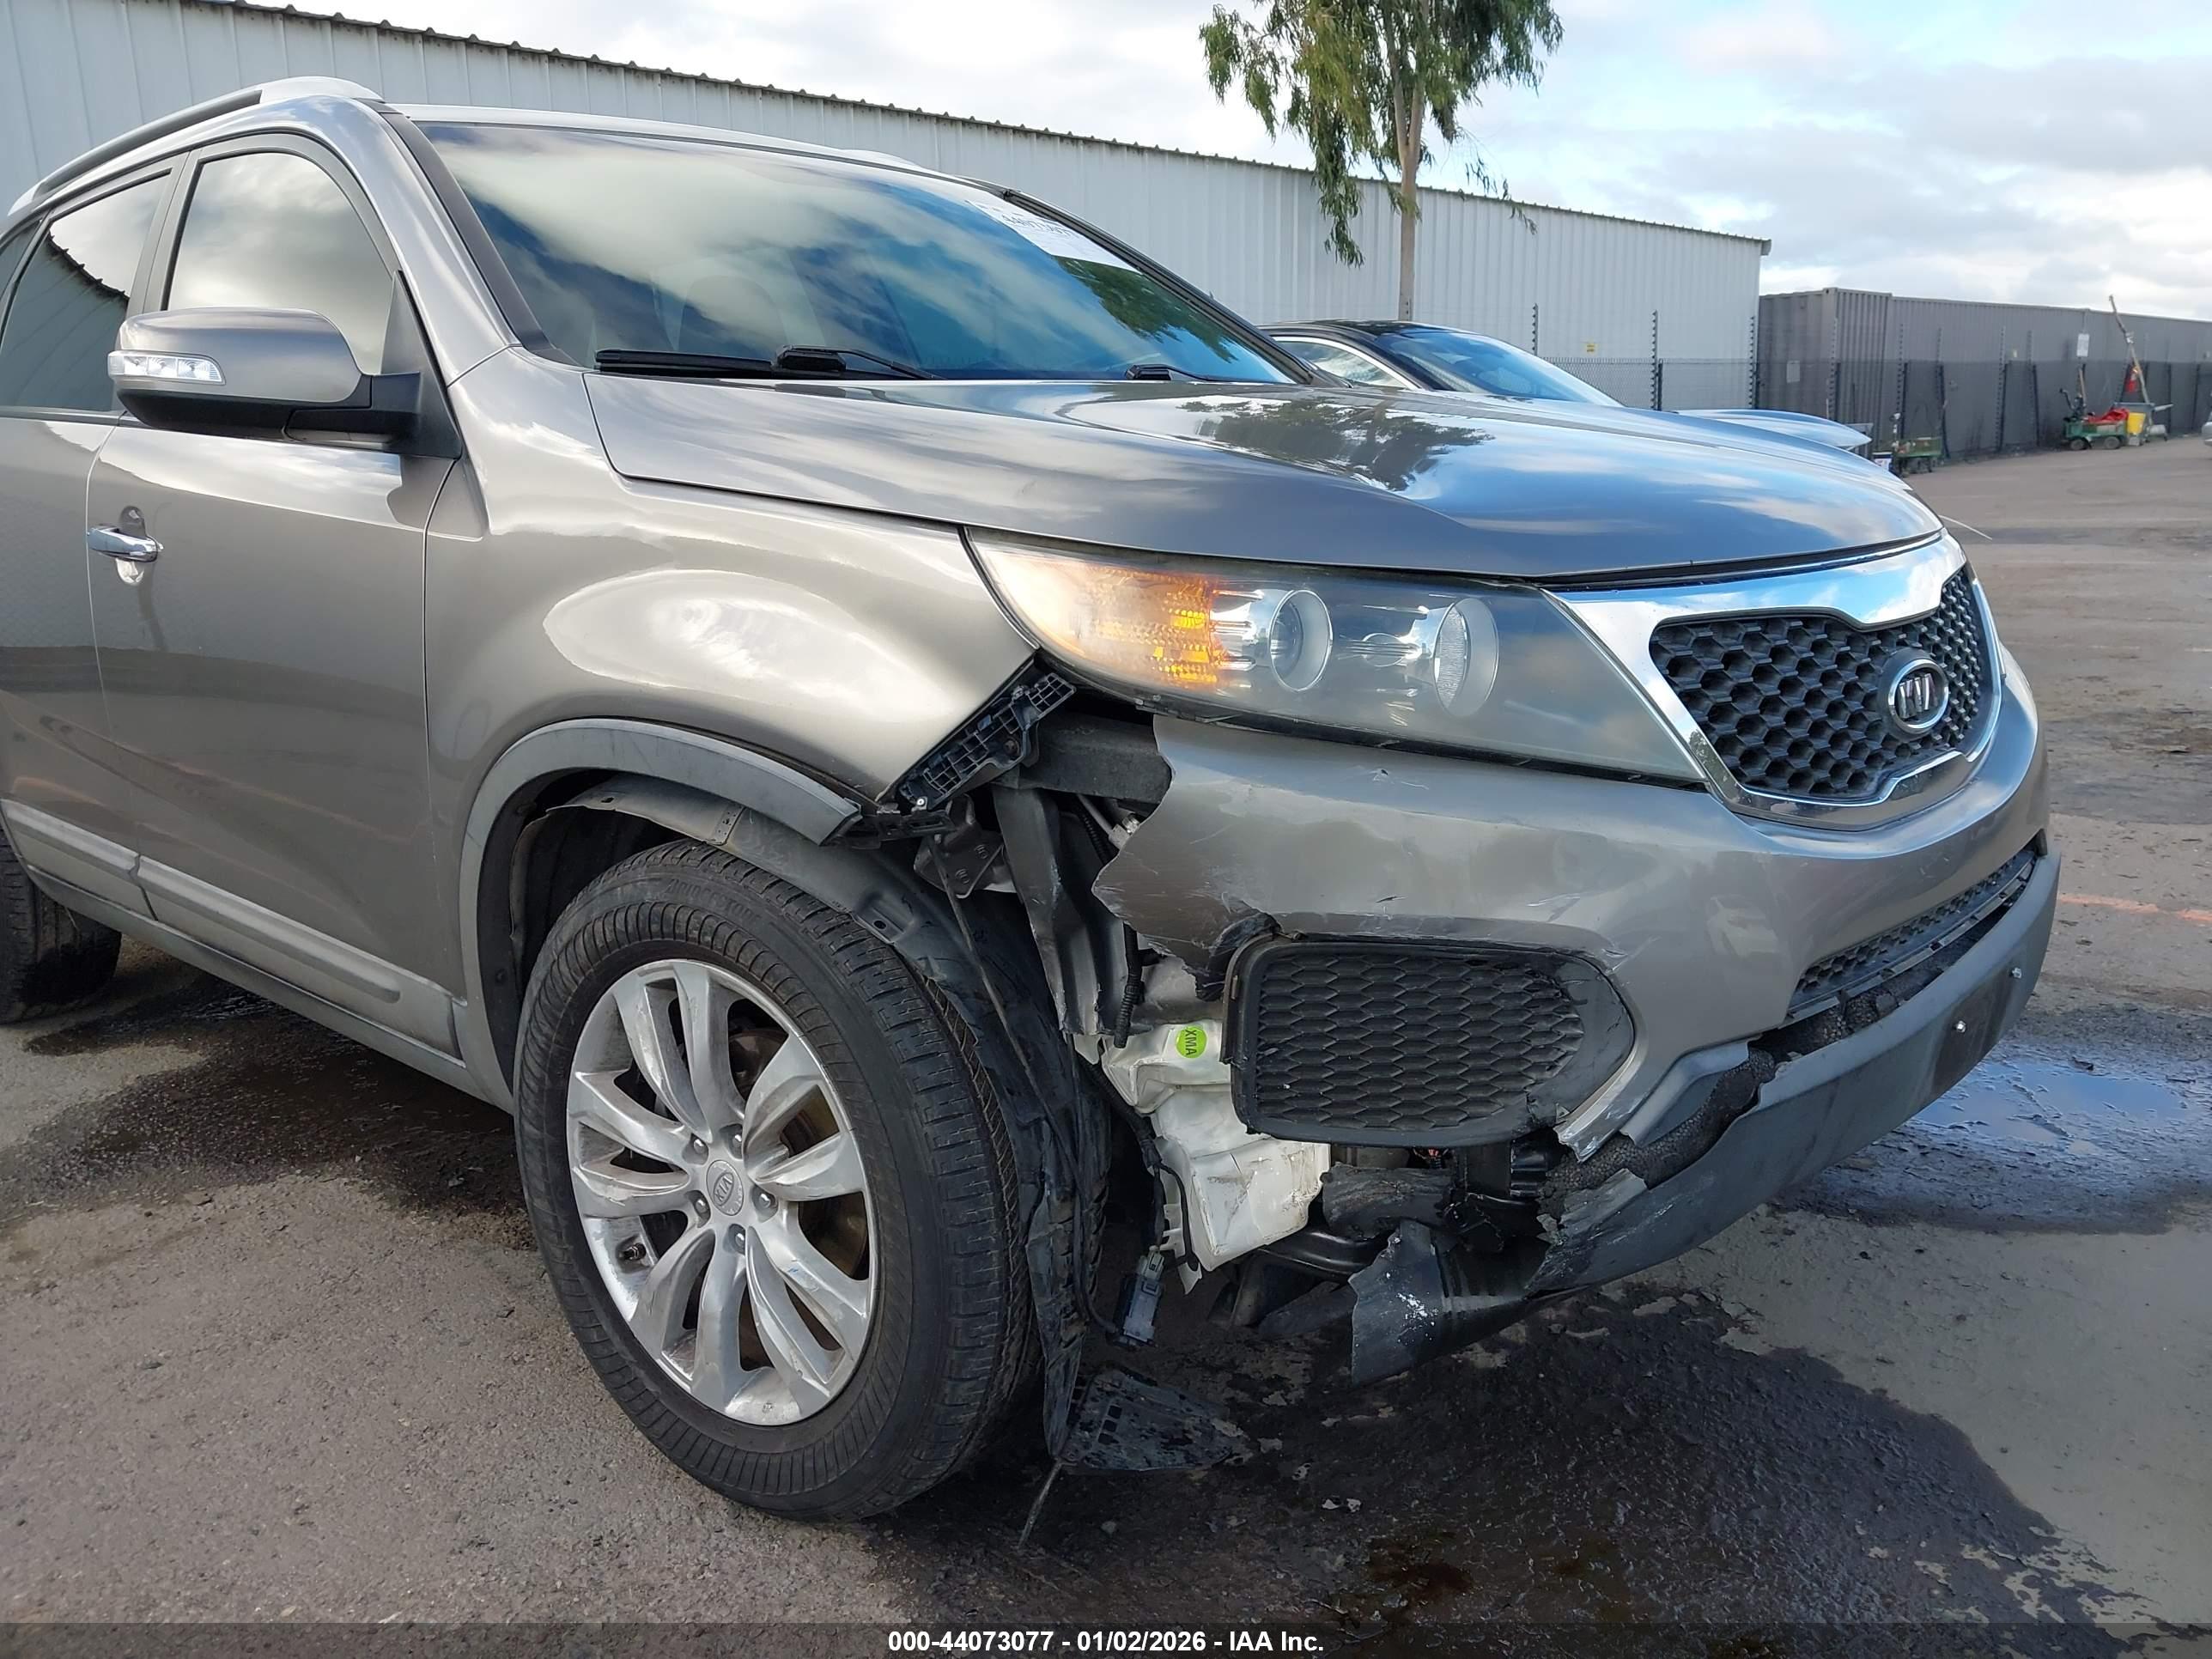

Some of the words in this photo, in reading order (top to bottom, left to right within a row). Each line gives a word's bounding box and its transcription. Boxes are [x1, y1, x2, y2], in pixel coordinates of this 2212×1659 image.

[1897, 672, 1939, 719] KIA
[1184, 1029, 1197, 1056] XMA
[714, 1176, 733, 1203] KIA
